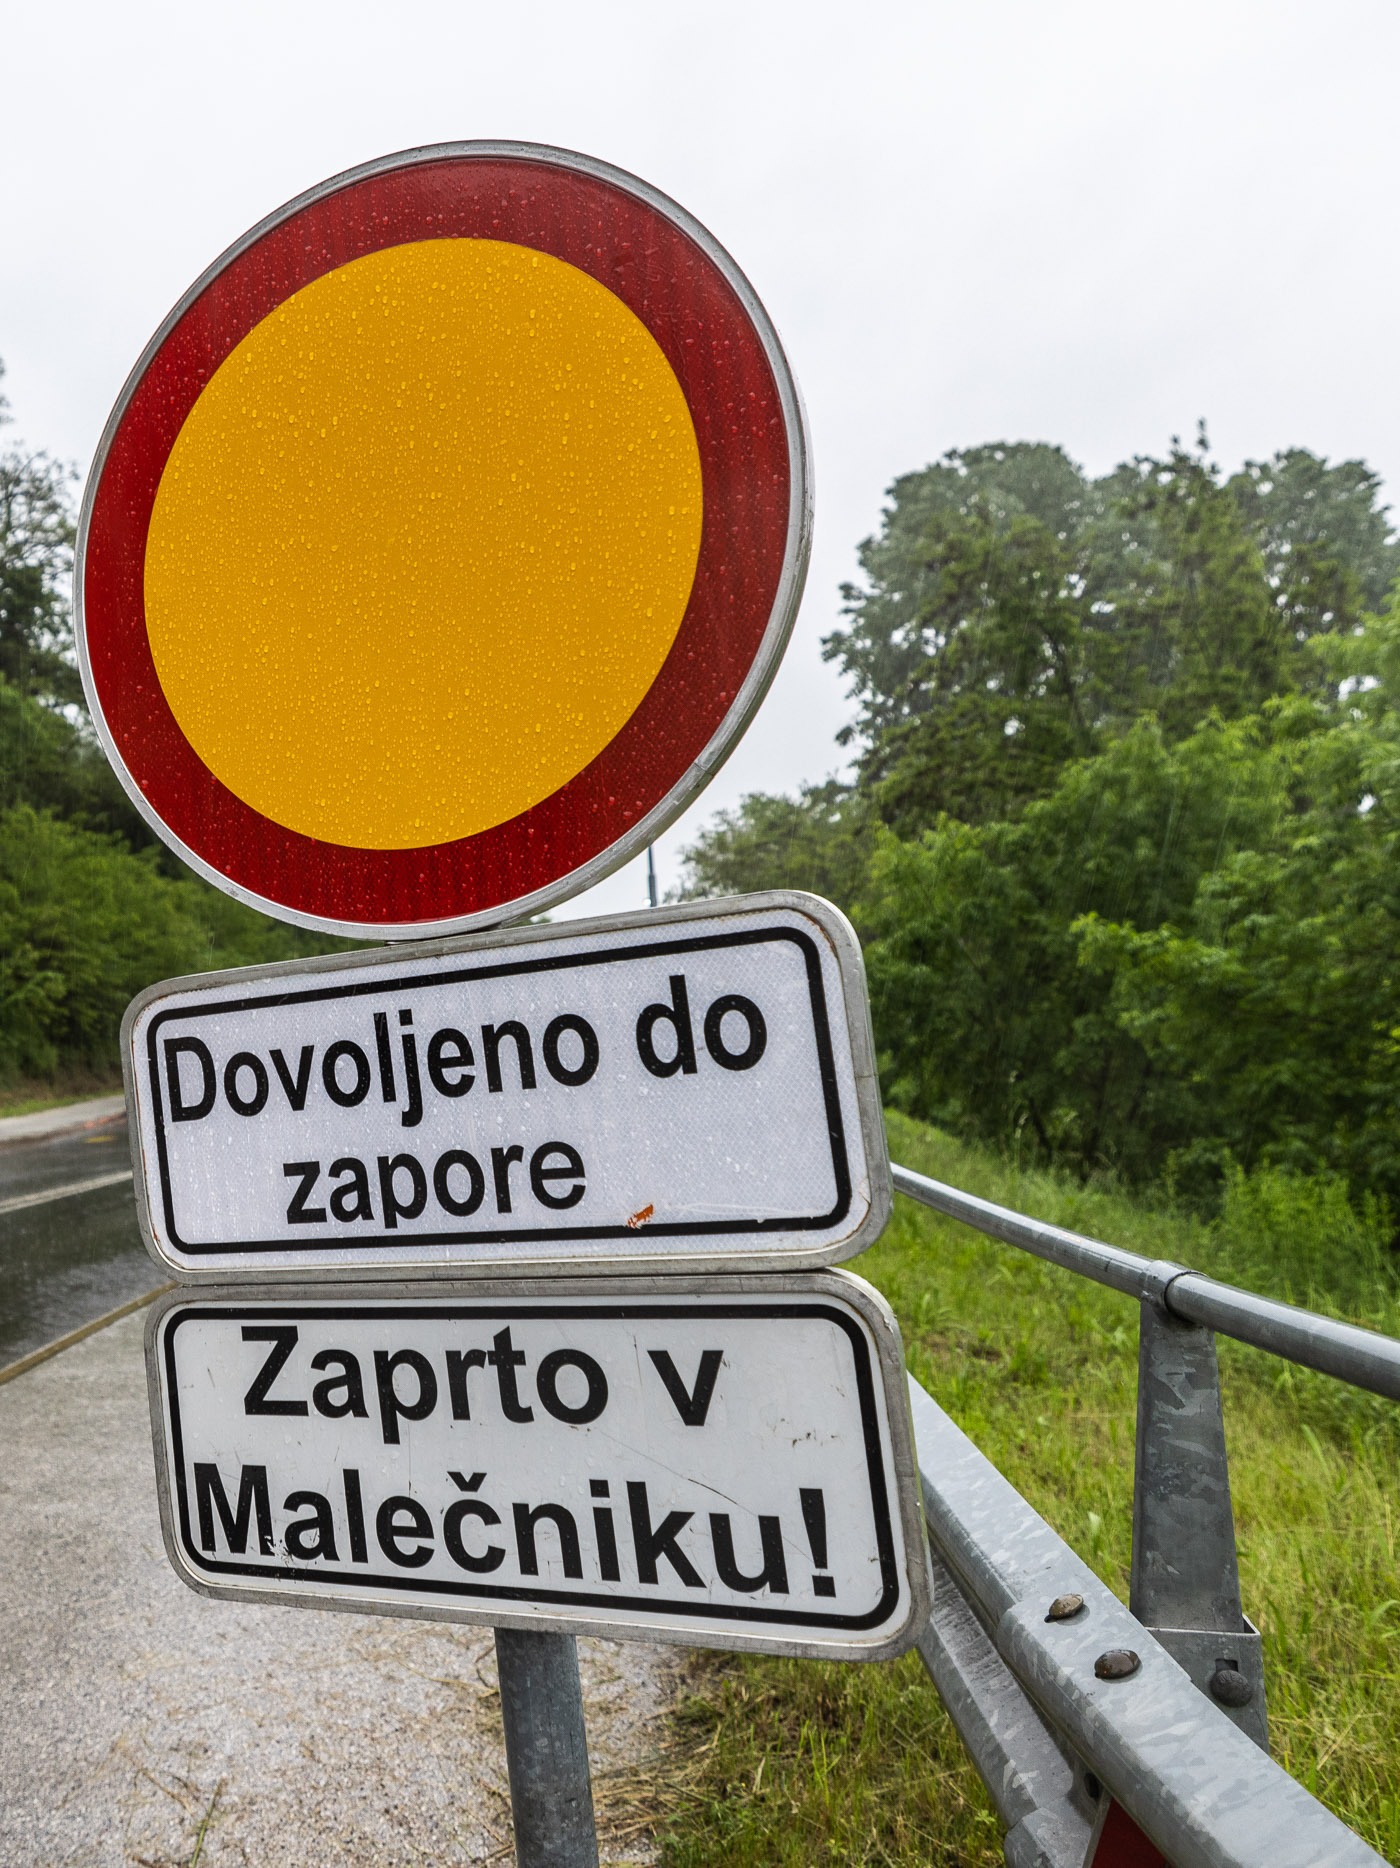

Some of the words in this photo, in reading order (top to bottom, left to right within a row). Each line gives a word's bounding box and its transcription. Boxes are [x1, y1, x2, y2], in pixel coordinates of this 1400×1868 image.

[163, 1009, 599, 1128] Dovoljeno
[636, 974, 767, 1079] do
[284, 1140, 587, 1229] zapore
[240, 1325, 609, 1445] Zaprto
[647, 1349, 724, 1427] v
[194, 1462, 836, 1598] Malečniku!
